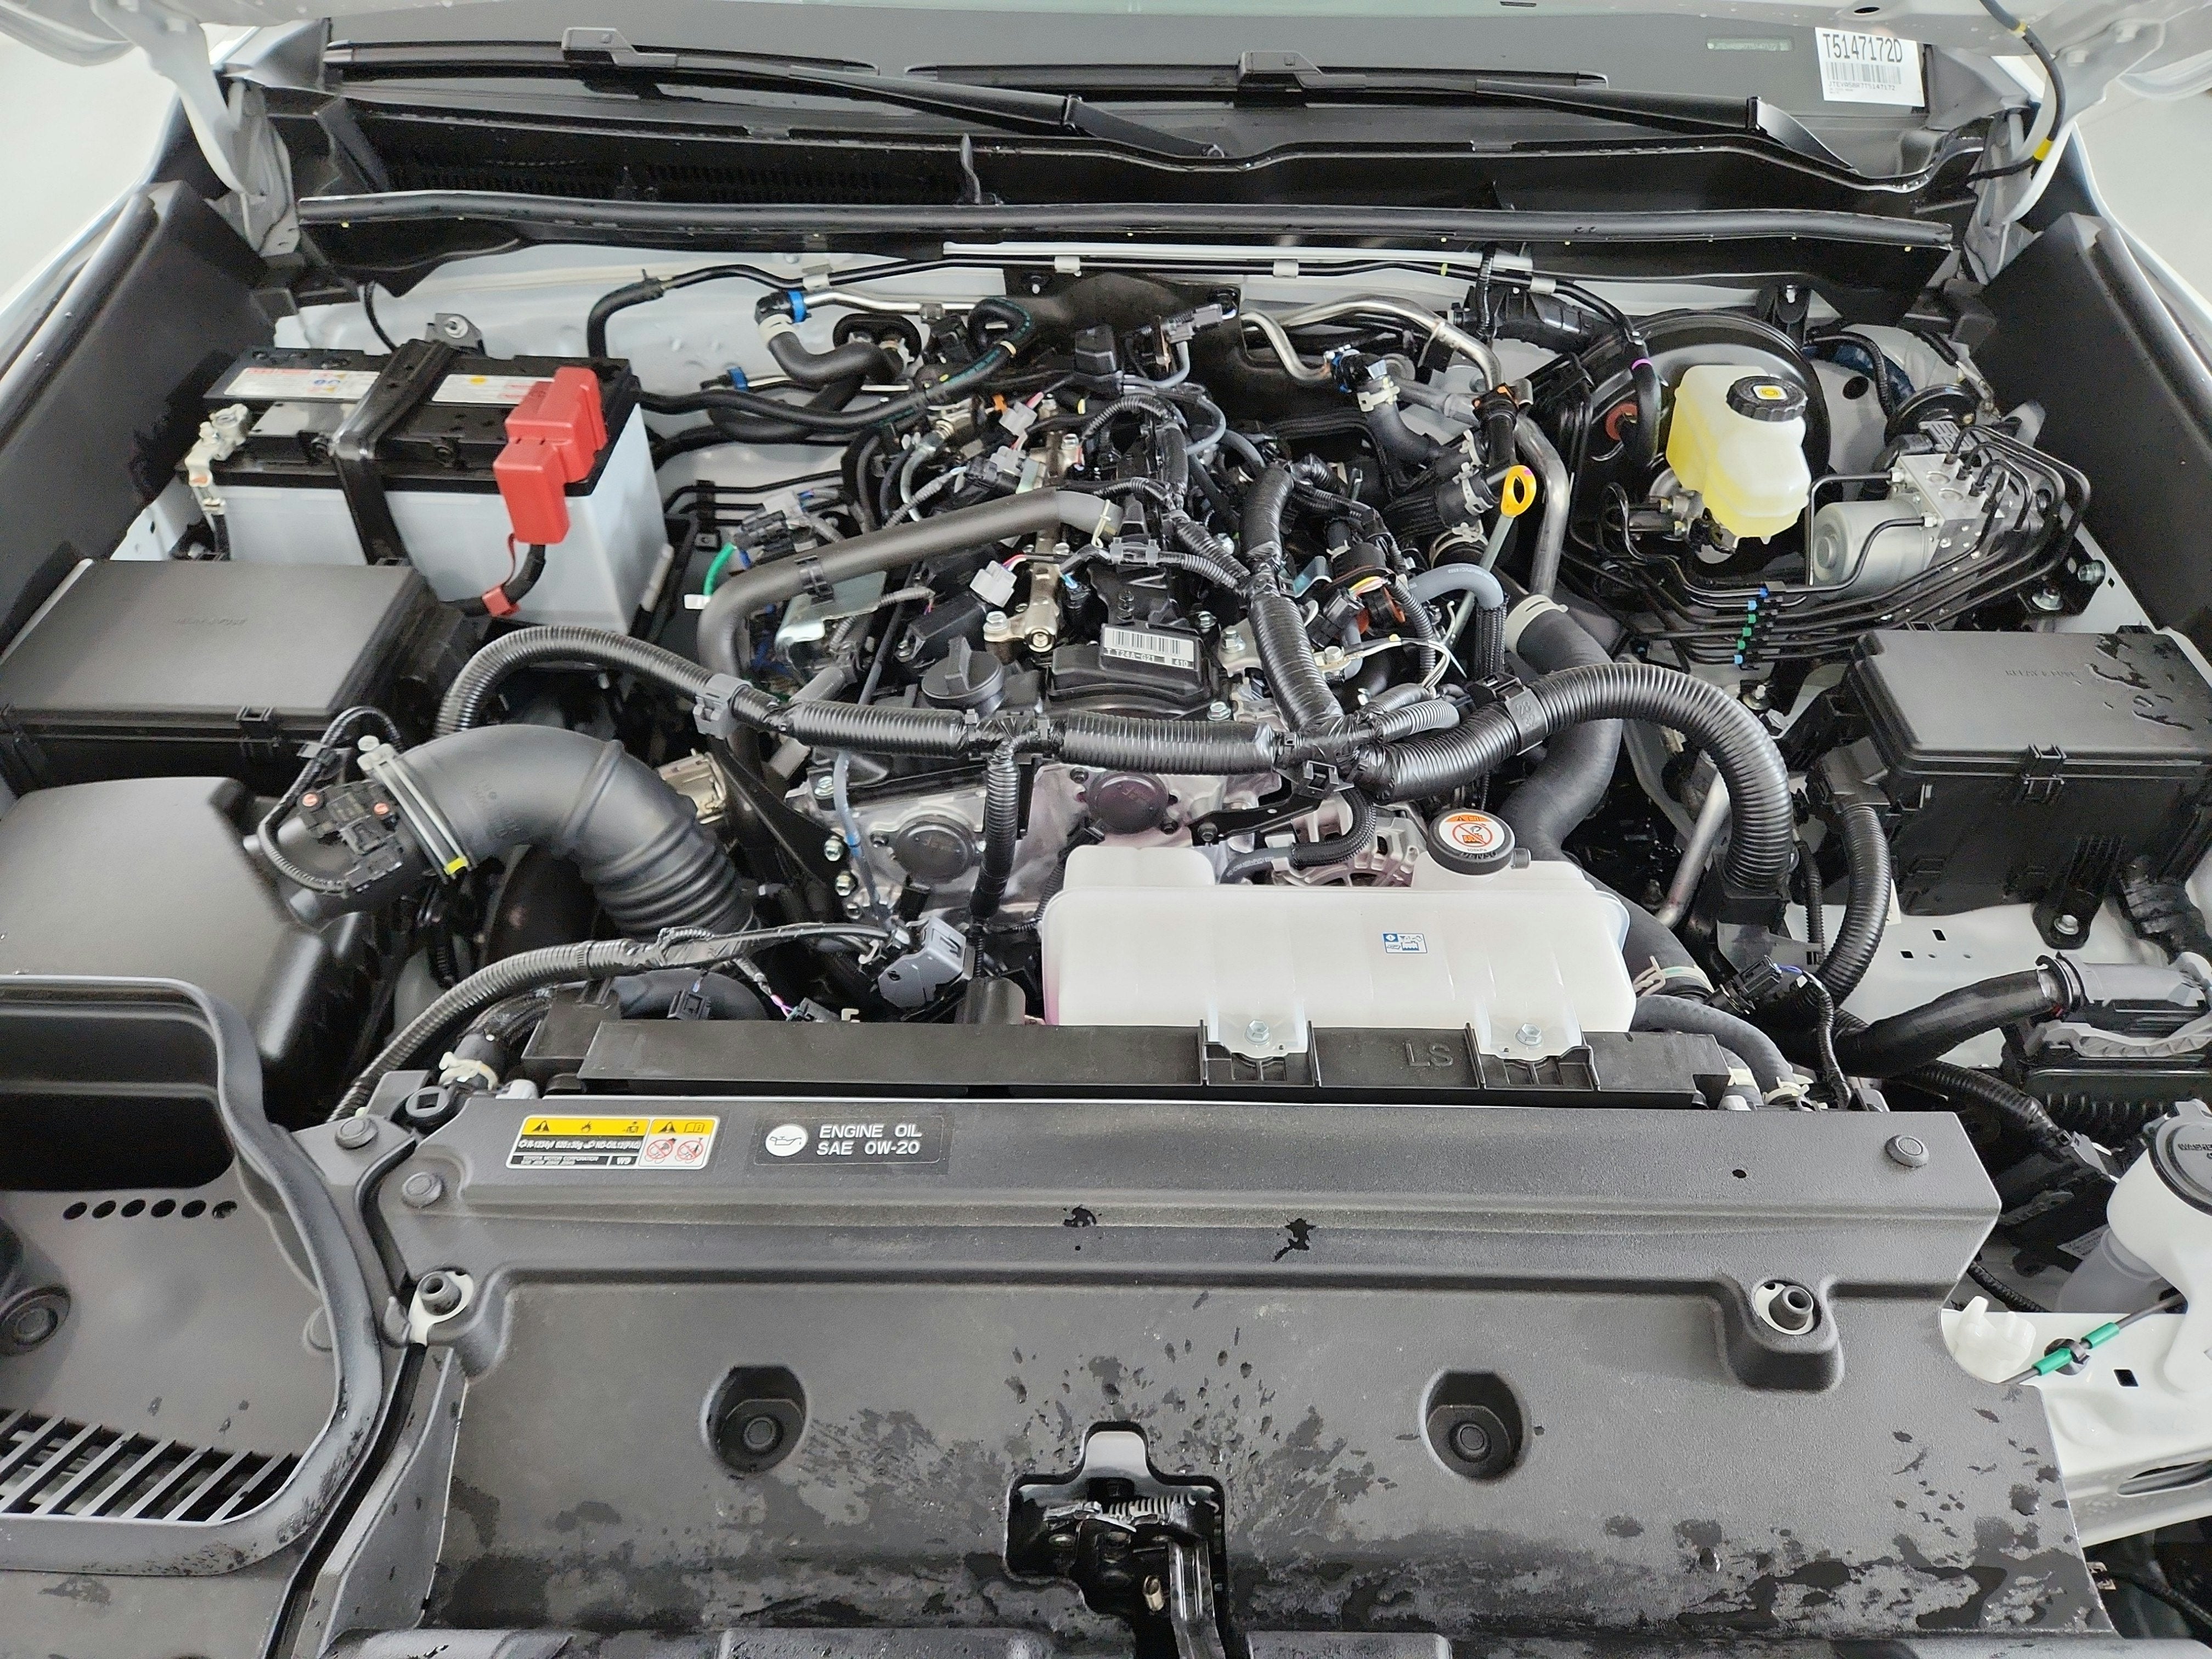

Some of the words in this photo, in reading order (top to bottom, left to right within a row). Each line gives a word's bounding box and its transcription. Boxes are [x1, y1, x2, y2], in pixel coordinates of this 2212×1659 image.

[1822, 33, 1903, 63] T5147172D
[1115, 650, 1154, 662] T24A-G21
[820, 1125, 884, 1138] ENGINE
[895, 1125, 923, 1138] OIL
[816, 1141, 855, 1155] SAE
[864, 1141, 921, 1155] 0W-20
[616, 1156, 632, 1165] W9
